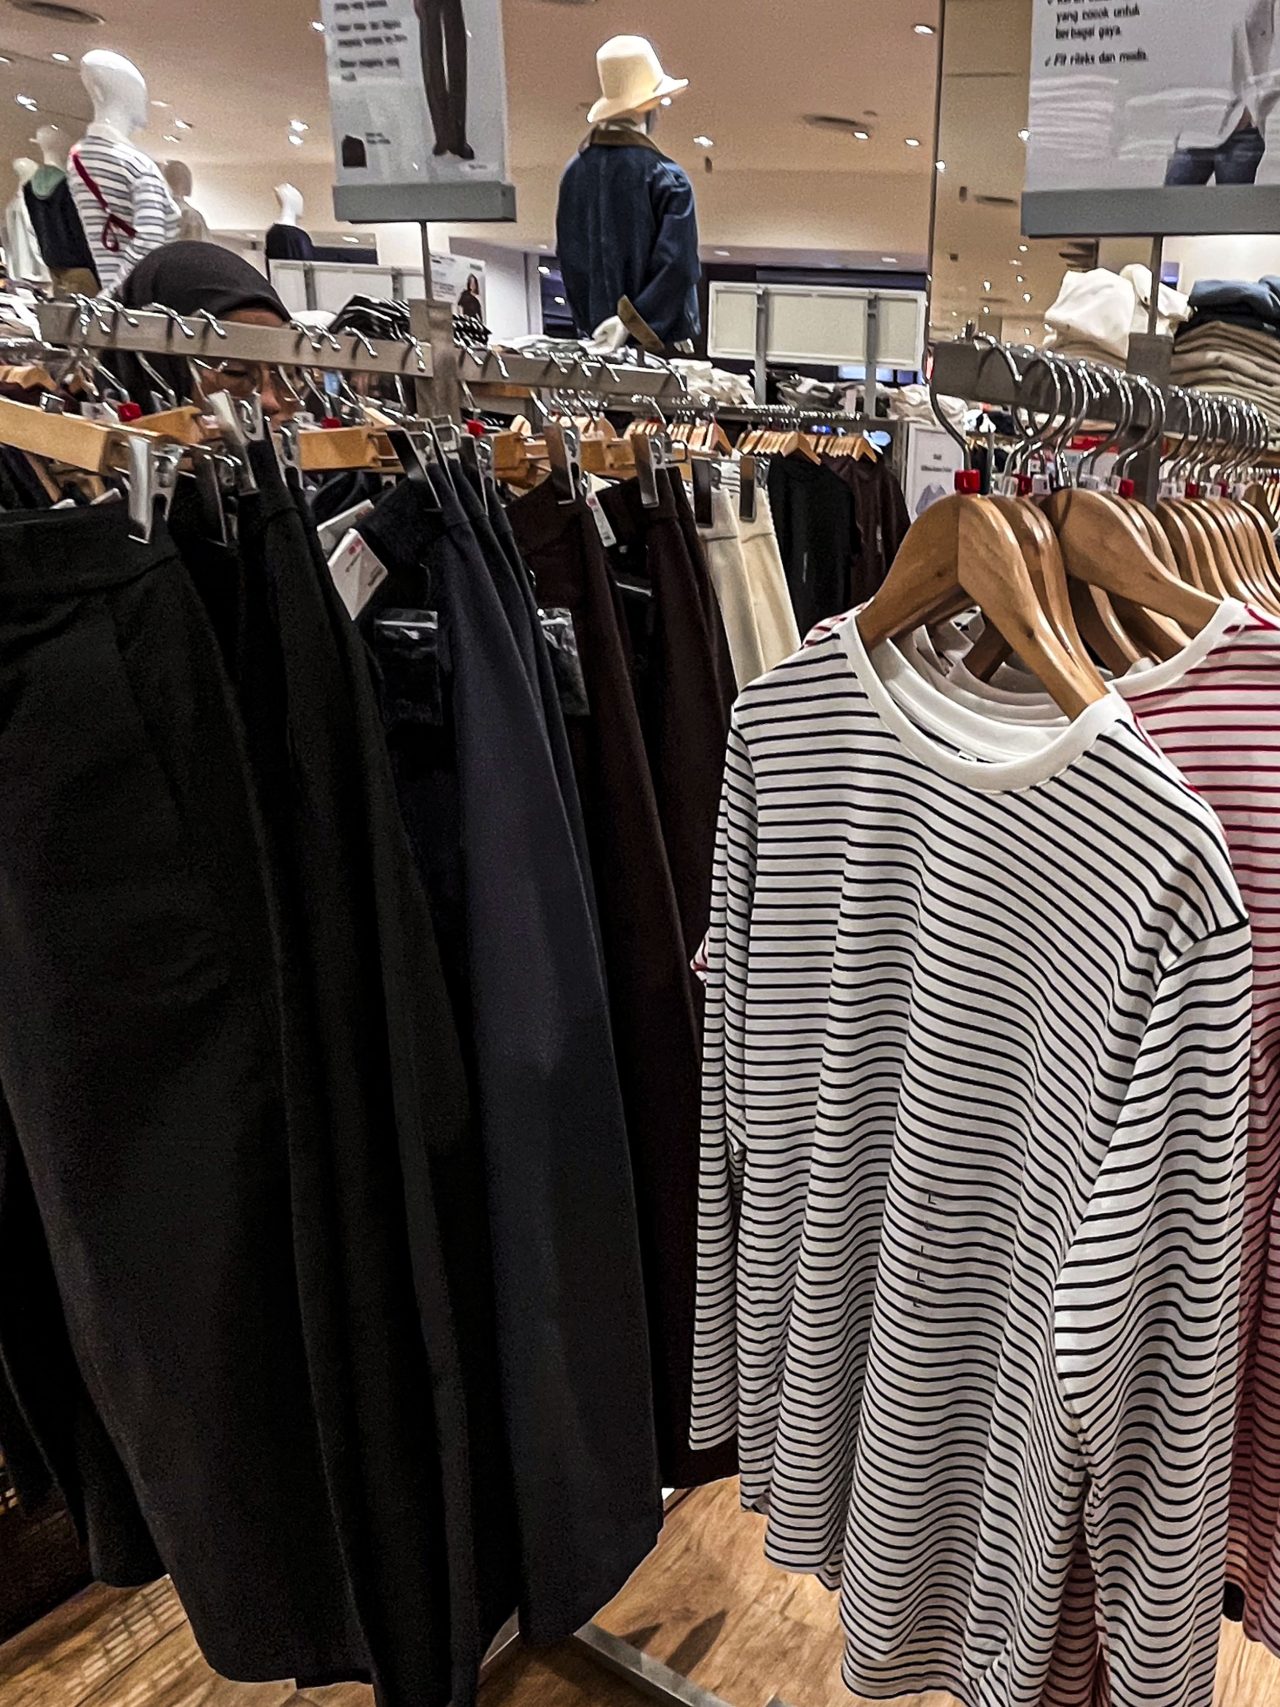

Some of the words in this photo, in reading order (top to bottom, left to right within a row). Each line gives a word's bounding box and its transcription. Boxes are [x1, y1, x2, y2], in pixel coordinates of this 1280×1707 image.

[1056, 10, 1078, 24] yang
[1113, 3, 1140, 18] untuk
[1055, 26, 1095, 41] berbagai
[1098, 50, 1116, 64] dan
